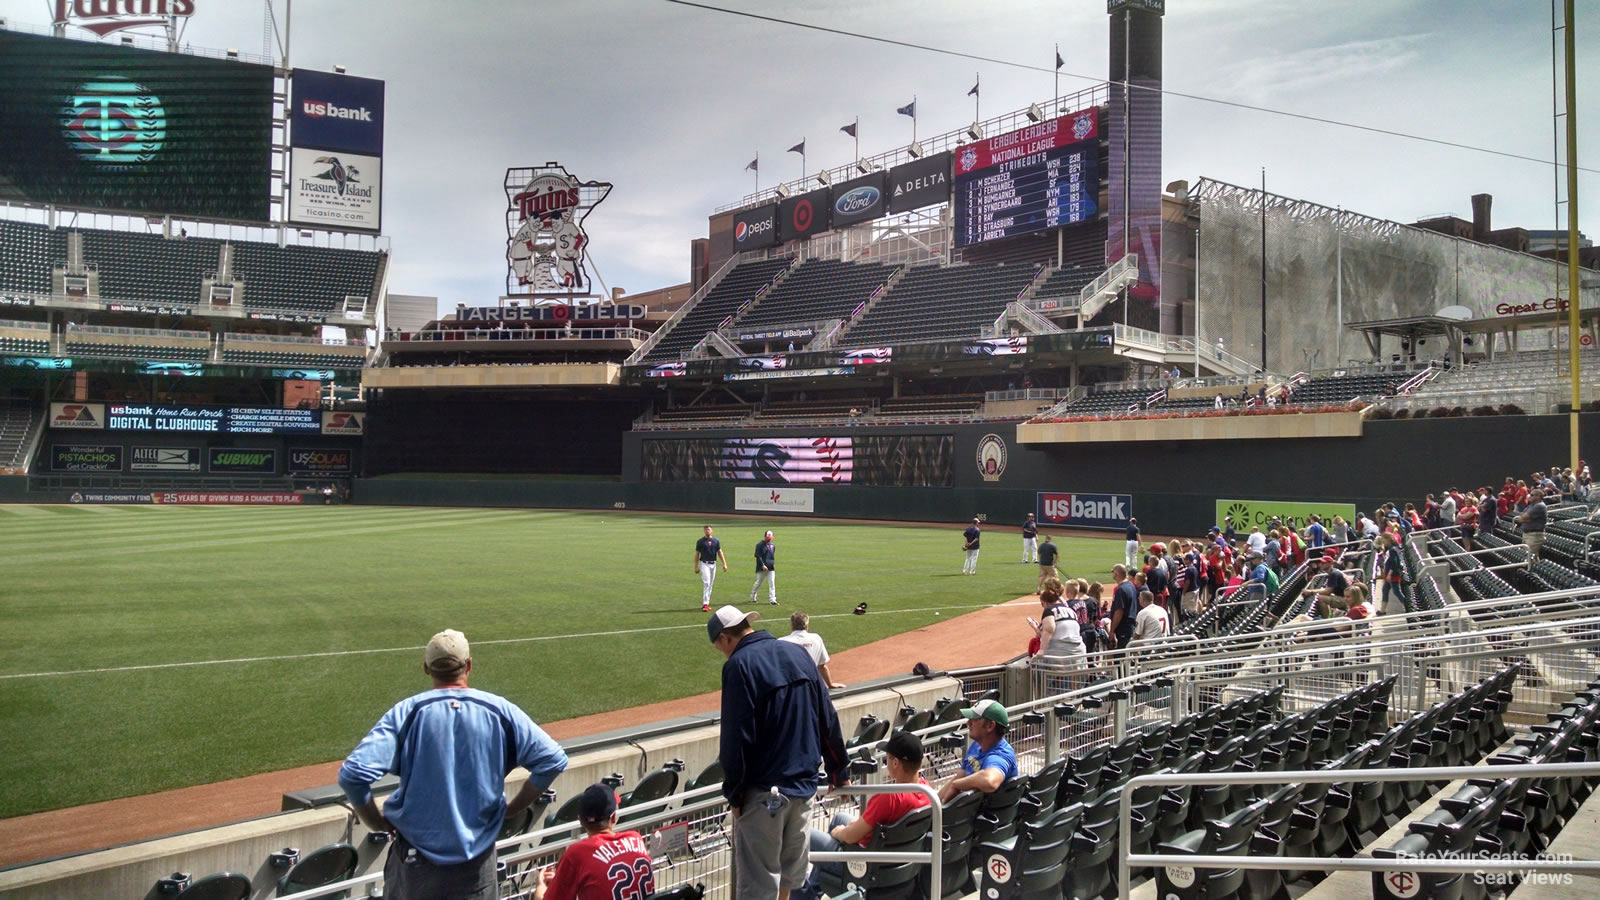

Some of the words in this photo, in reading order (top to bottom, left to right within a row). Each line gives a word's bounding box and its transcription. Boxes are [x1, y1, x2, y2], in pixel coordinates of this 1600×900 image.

[990, 131, 1019, 150] LEAGUE
[1020, 120, 1058, 141] LEADERS
[992, 145, 1025, 164] NATIONAL
[1028, 136, 1055, 154] LEAGUE
[984, 172, 1010, 186] SCHERZER
[1046, 158, 1060, 169] WSH
[1000, 152, 1047, 173] STRIKEOUTS
[299, 178, 337, 194] Treasure
[345, 184, 372, 198] Island
[906, 172, 945, 193] DELTA
[984, 180, 1014, 195] FERNANDEZ
[1048, 168, 1059, 179] MIA
[984, 189, 1016, 204] BUMGARNER
[1049, 178, 1057, 188] SF
[513, 187, 579, 222] Twins
[843, 191, 871, 211] Ford
[984, 196, 1021, 213] SYNDERGAARD
[1046, 187, 1060, 198] NYM
[984, 212, 994, 222] RAY
[1048, 198, 1058, 208] ARI
[306, 208, 364, 220] ticasino.com
[984, 217, 1014, 232] STRASBURG
[1046, 207, 1060, 218] WSH
[748, 216, 773, 237] pepsi
[984, 229, 1006, 241] ARRIETA
[1047, 217, 1059, 228] CHC
[456, 306, 544, 321] TARGET
[574, 304, 645, 320] FIELD
[1496, 302, 1537, 315] Great
[155, 407, 178, 416] Home
[179, 408, 197, 417] Run
[198, 408, 224, 418] Porch
[110, 417, 152, 429] DIGITAL
[155, 418, 219, 431] CLUBHOUSE
[59, 453, 116, 463] PISTACHIOS
[134, 448, 158, 459] ALTEC
[213, 453, 272, 465] SUBWAY
[163, 493, 178, 503] 25
[250, 495, 273, 503] CHANCE
[607, 857, 655, 900] 22
